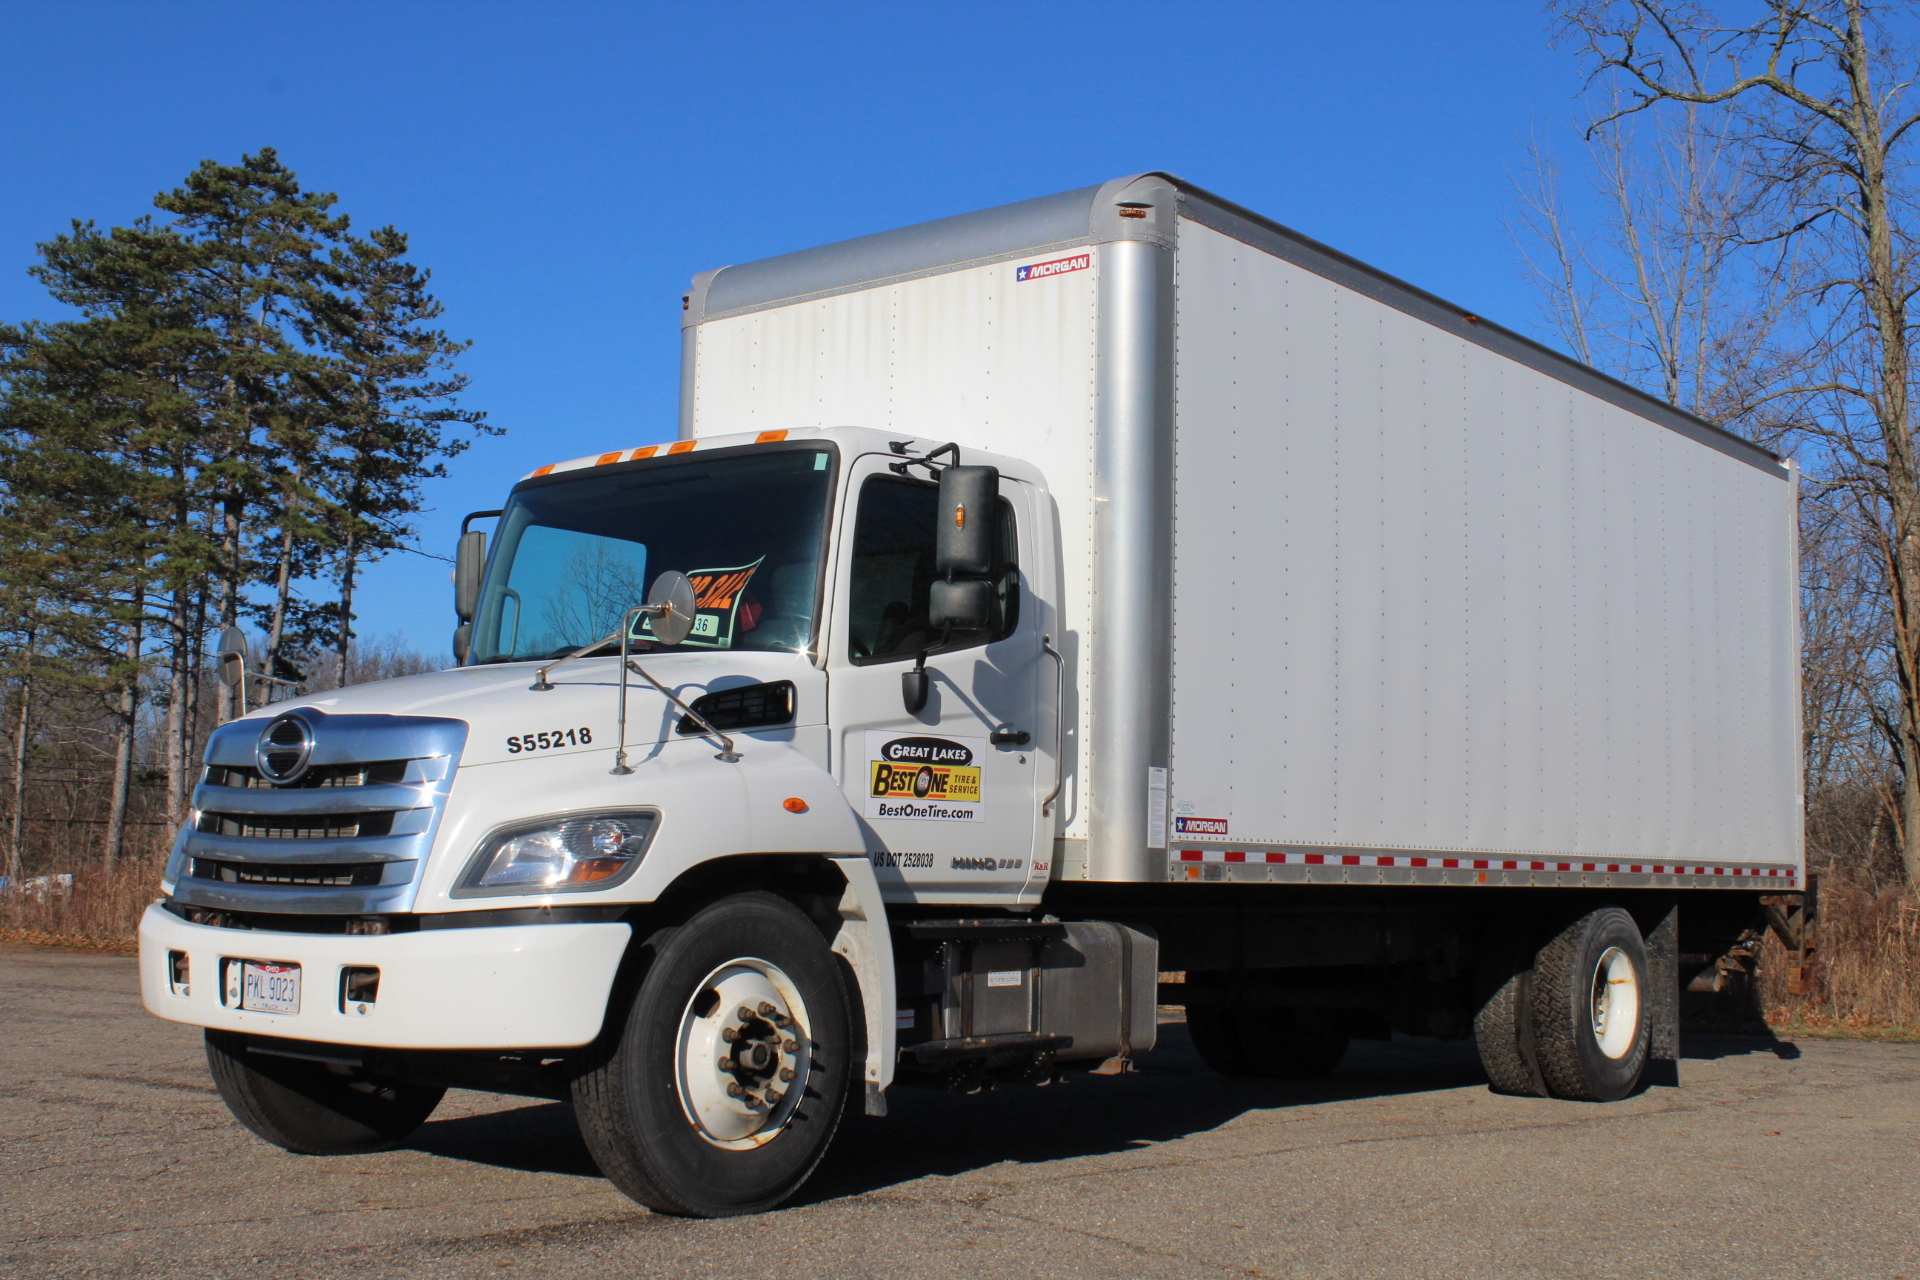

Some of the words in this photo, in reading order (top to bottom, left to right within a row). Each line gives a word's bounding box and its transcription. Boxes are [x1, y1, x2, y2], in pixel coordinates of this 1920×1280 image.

[1030, 256, 1087, 278] MORGAN
[506, 727, 592, 754] S55218
[889, 744, 929, 759] GREAT
[931, 747, 967, 761] LAKES
[954, 774, 970, 784] TIRE
[971, 775, 977, 784] &
[949, 785, 978, 795] SERVICE
[879, 803, 973, 819] BestOneTire.com
[1185, 820, 1226, 833] MORGAN
[873, 852, 885, 867] US
[886, 852, 902, 868] DOT
[903, 852, 934, 868] 2528038
[950, 856, 997, 871] HINO
[1033, 861, 1049, 871] R&R
[265, 965, 280, 973] OHIO
[247, 974, 265, 999] PKL
[269, 976, 294, 1002] 9023
